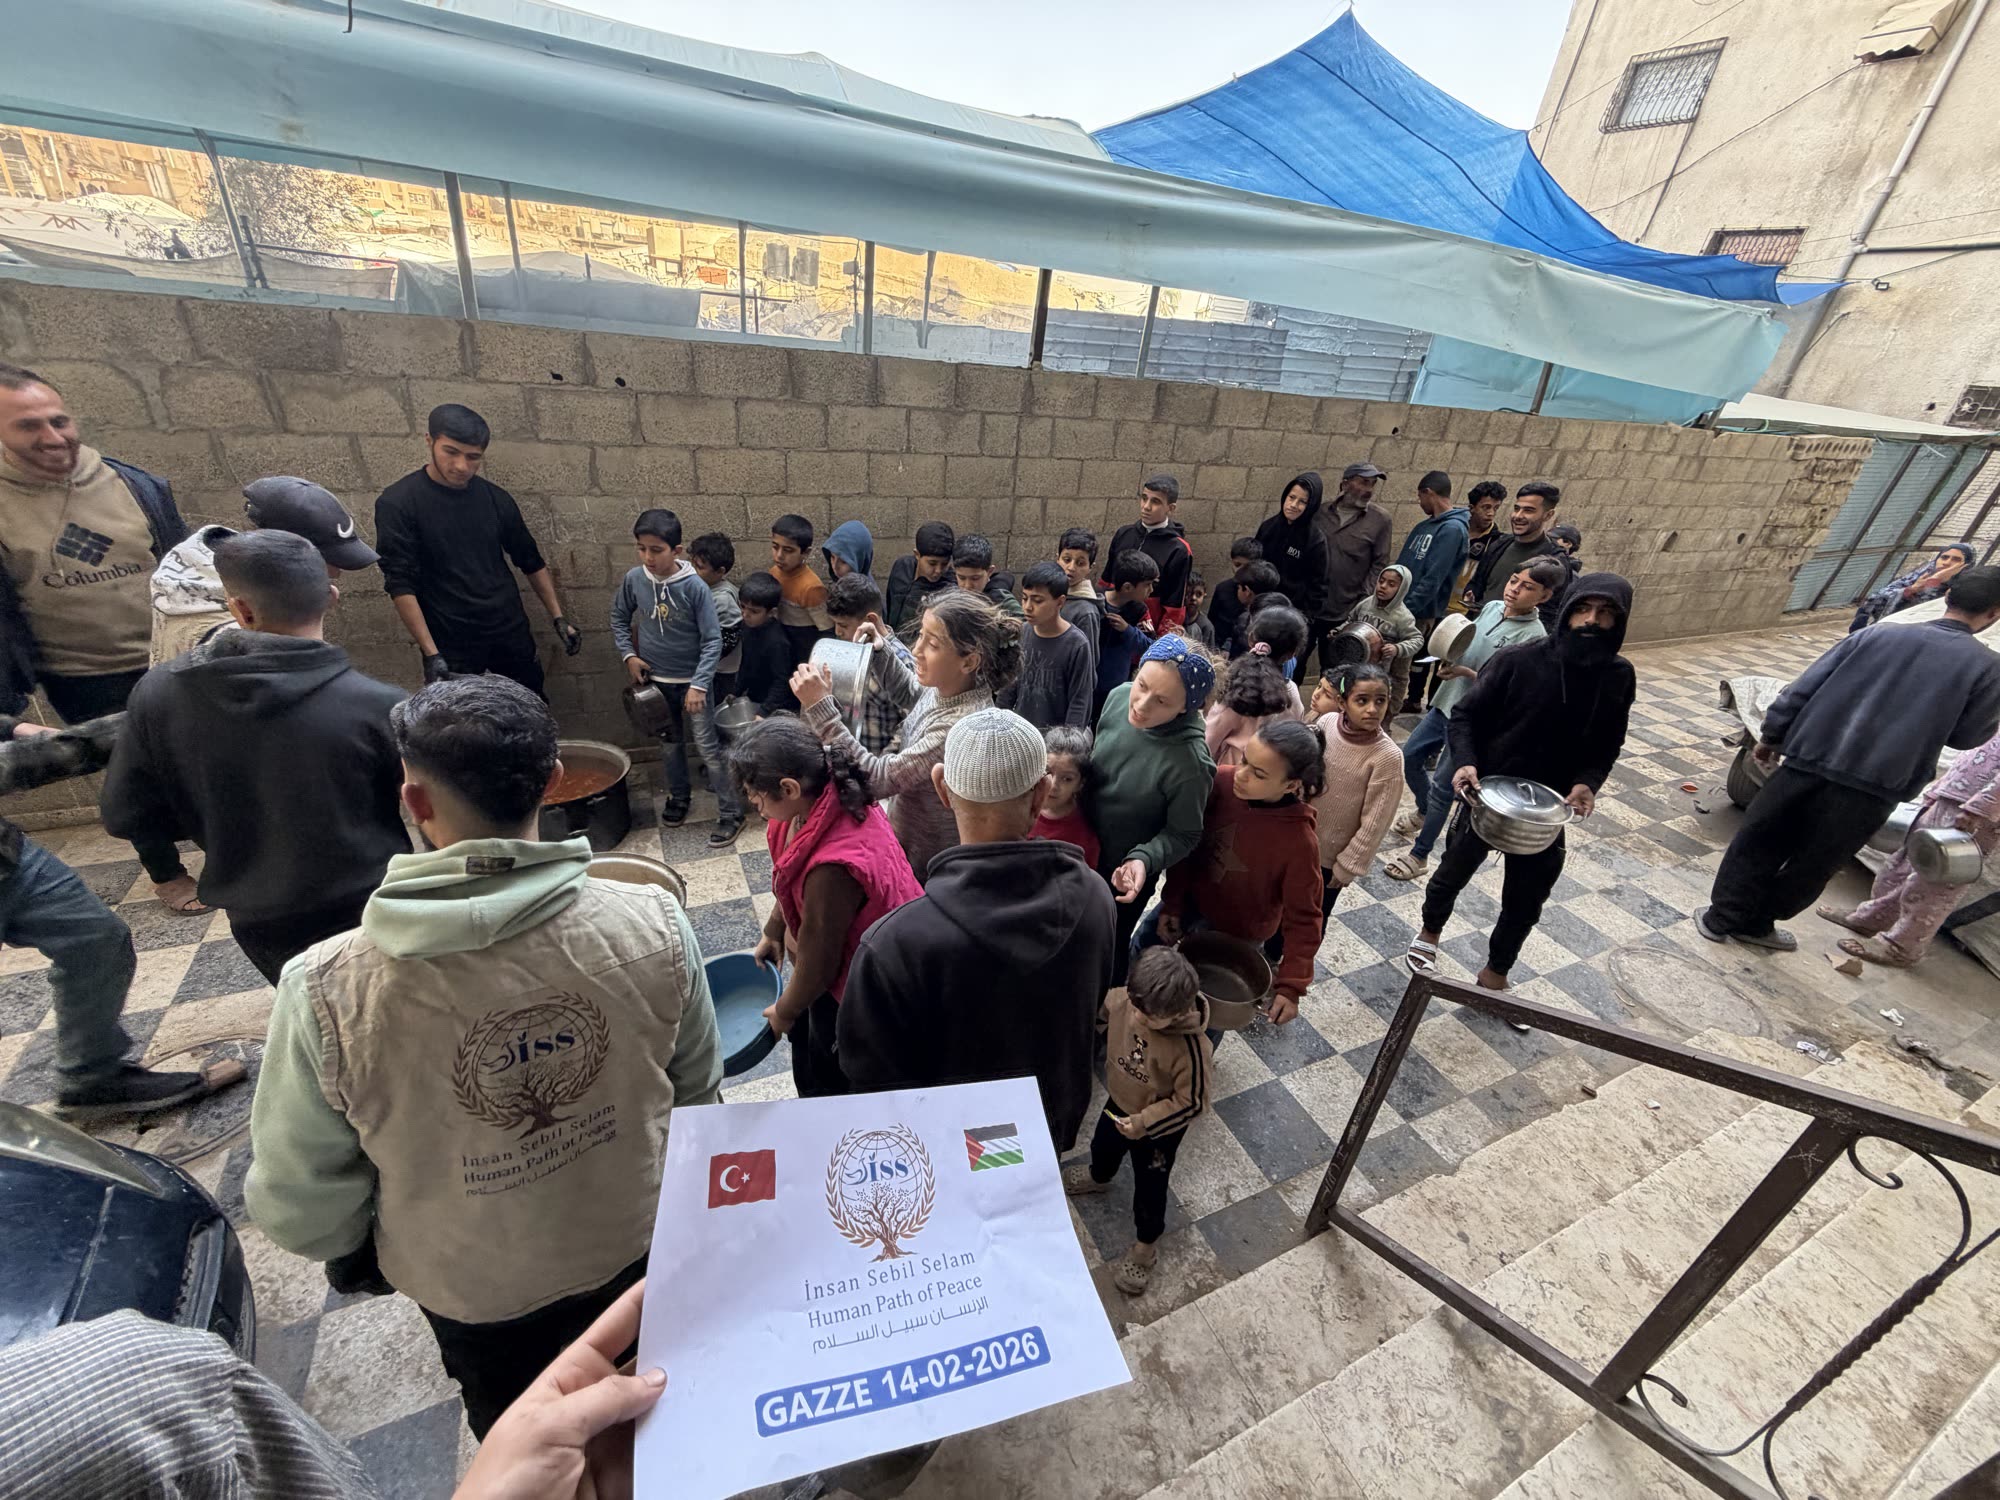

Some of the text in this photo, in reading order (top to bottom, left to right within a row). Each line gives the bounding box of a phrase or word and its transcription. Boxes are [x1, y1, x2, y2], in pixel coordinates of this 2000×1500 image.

[42, 562, 142, 588] Columbia
[570, 1104, 616, 1133] Selam
[464, 1165, 521, 1184] Human
[526, 1146, 560, 1170] Path
[804, 1251, 976, 1302] İnsan Sebil Selam
[808, 1275, 983, 1329] Human Path of Peace
[761, 1332, 1041, 1428] GAZZE 14-02-2026
